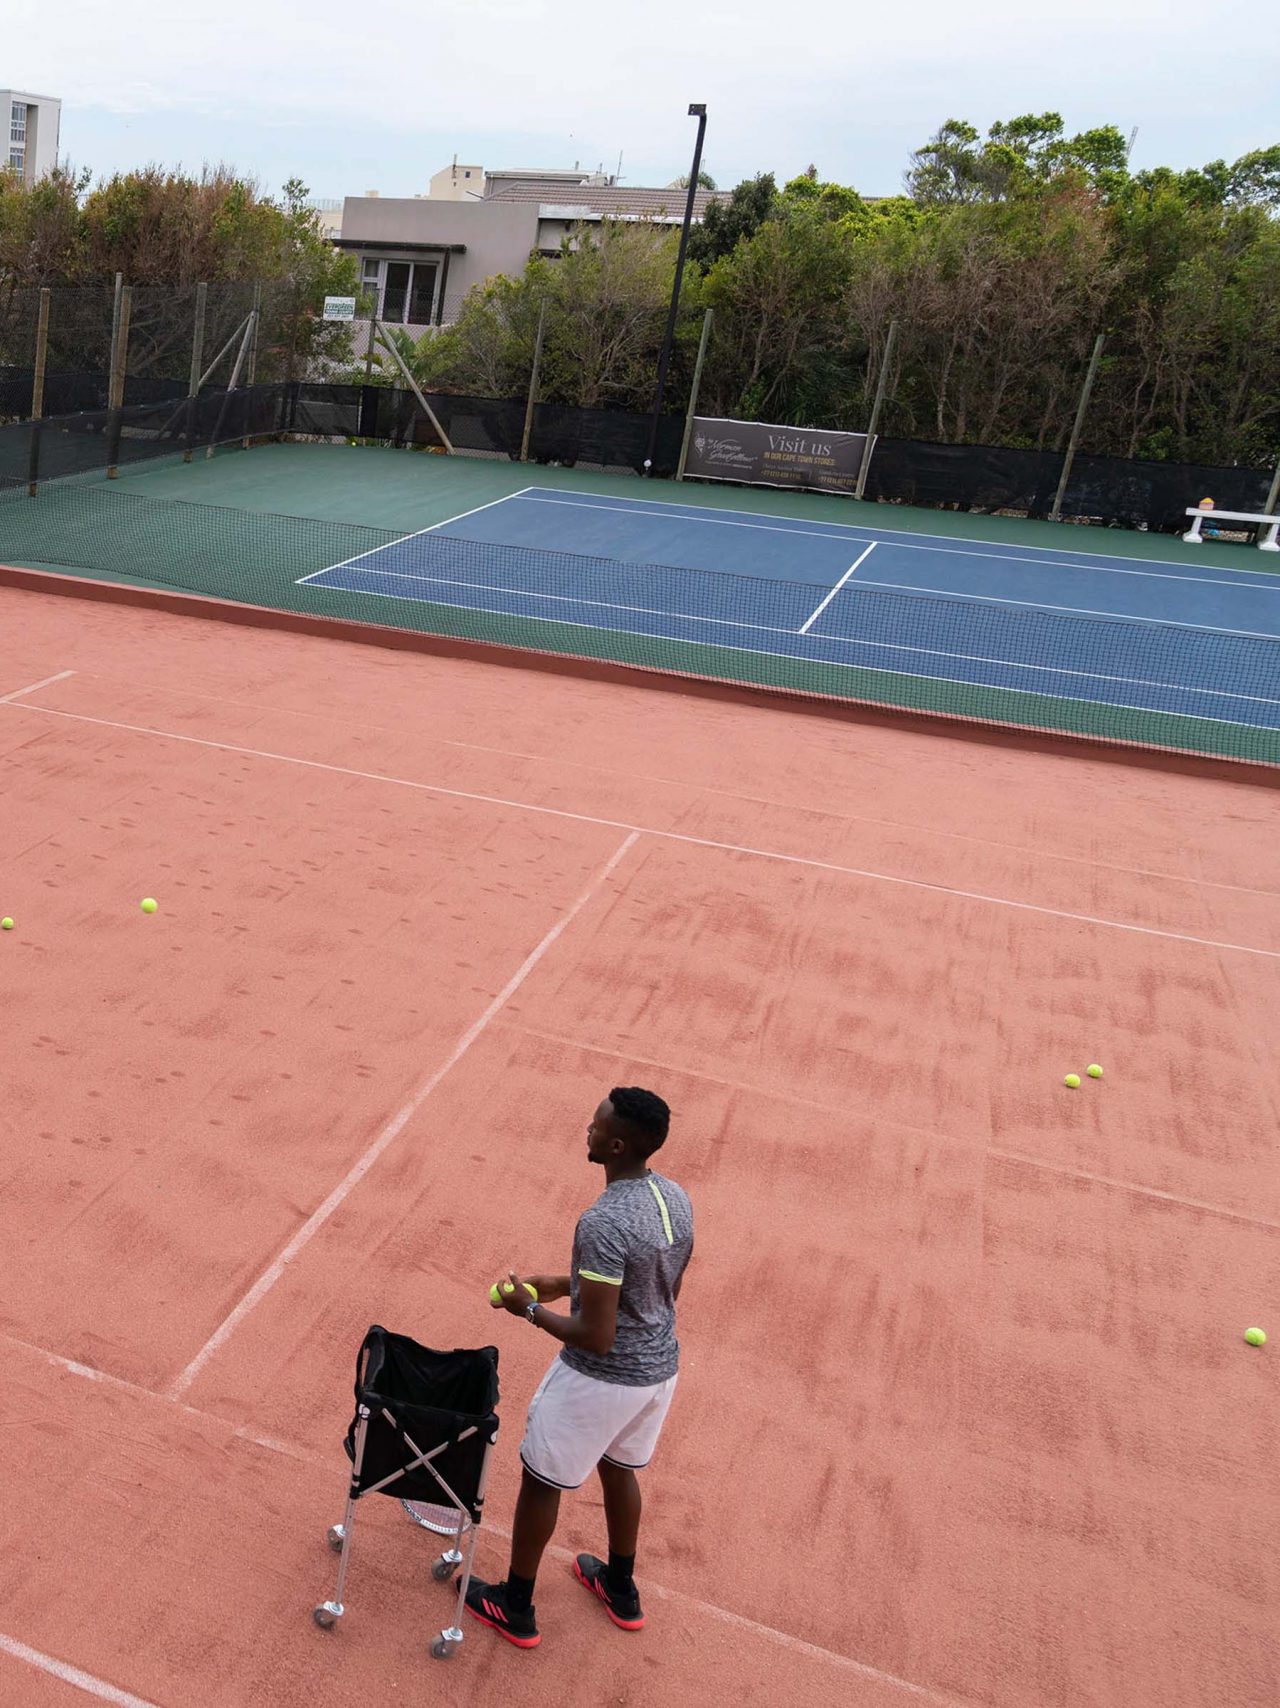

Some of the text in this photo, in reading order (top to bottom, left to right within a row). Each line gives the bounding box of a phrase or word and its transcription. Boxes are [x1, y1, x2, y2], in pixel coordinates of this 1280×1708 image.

[769, 435, 831, 456] Visit us
[782, 453, 797, 462] CAPE
[797, 455, 813, 463] TOWN
